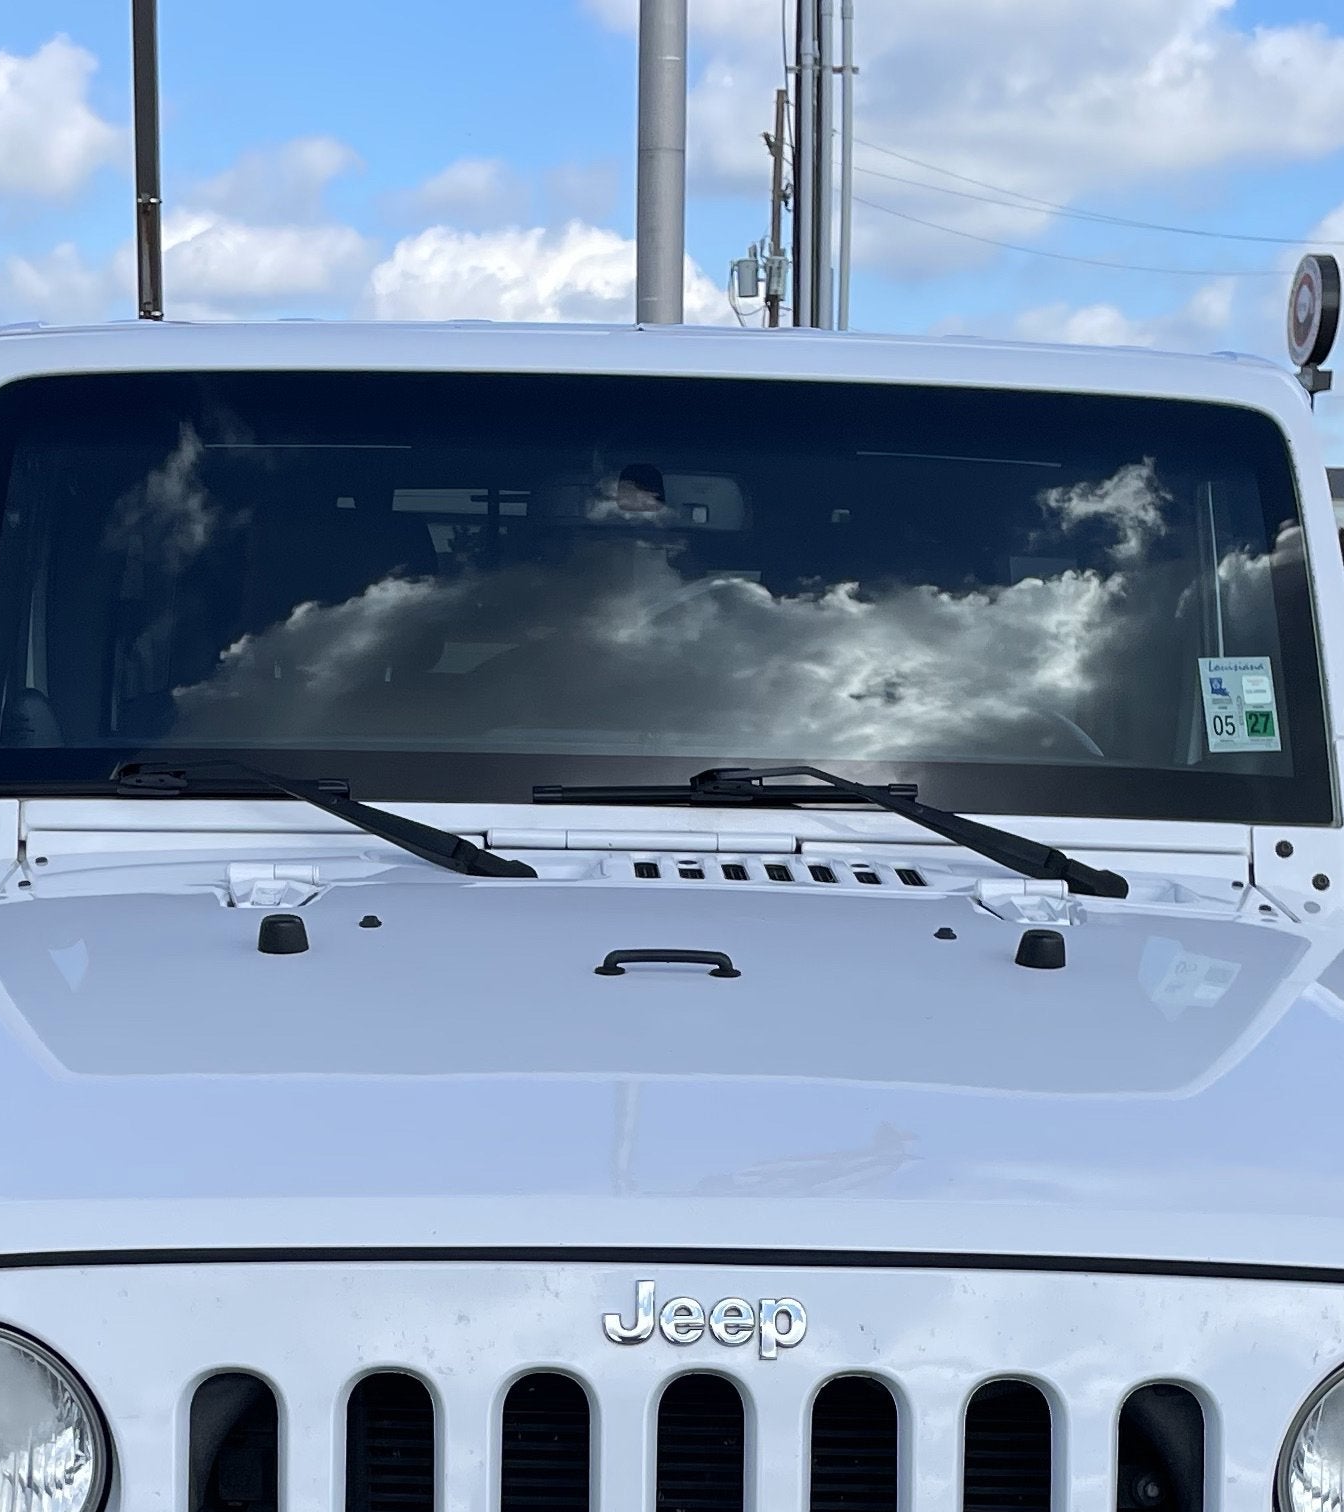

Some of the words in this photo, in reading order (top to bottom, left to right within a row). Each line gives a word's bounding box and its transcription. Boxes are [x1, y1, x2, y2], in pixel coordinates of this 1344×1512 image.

[1208, 660, 1265, 673] Louisiana
[1213, 714, 1236, 736] 05
[1248, 713, 1271, 734] 27
[602, 1279, 807, 1360] Jeep
